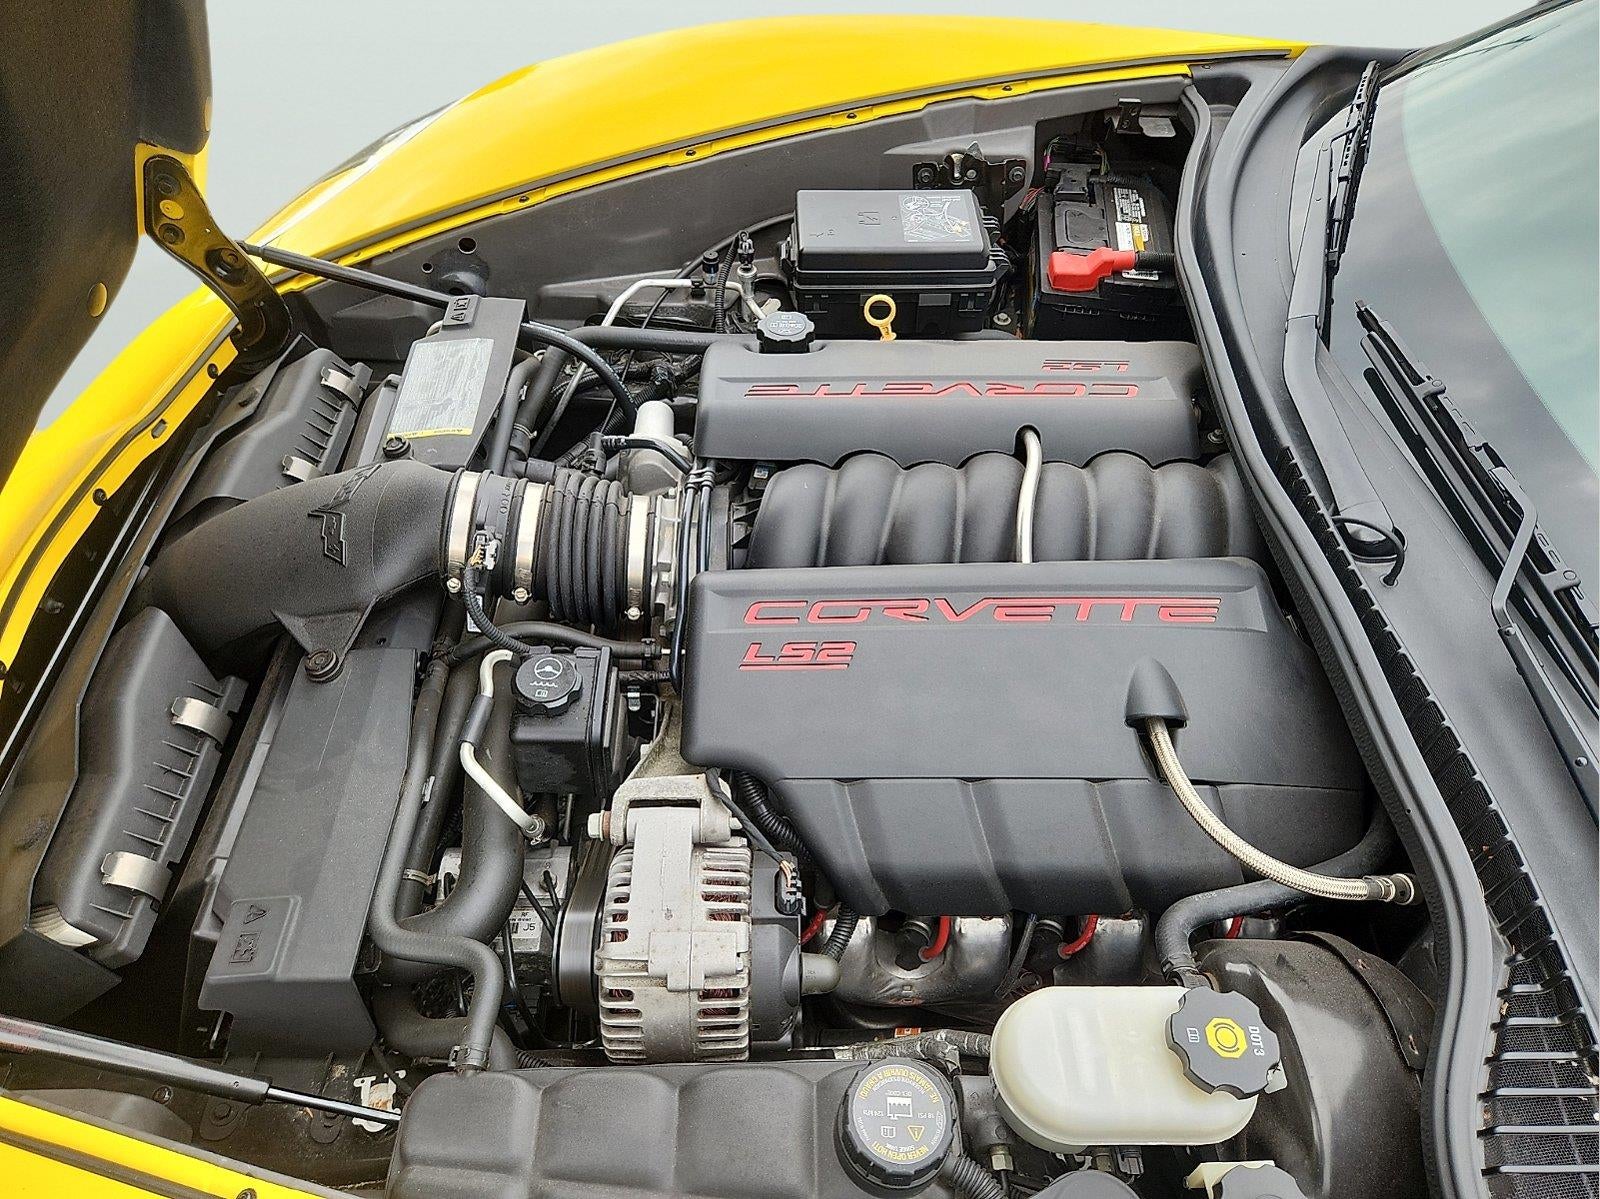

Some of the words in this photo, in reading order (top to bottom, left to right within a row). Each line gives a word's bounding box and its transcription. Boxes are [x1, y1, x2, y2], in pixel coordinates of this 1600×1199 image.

[1042, 359, 1131, 373] LS2
[744, 383, 1139, 398] CORVETTE
[743, 597, 1221, 624] CORVETTE
[740, 641, 857, 662] LS2
[872, 1141, 888, 1155] HOT!
[888, 1149, 907, 1160] OPEN
[907, 1145, 928, 1159] NEVER
